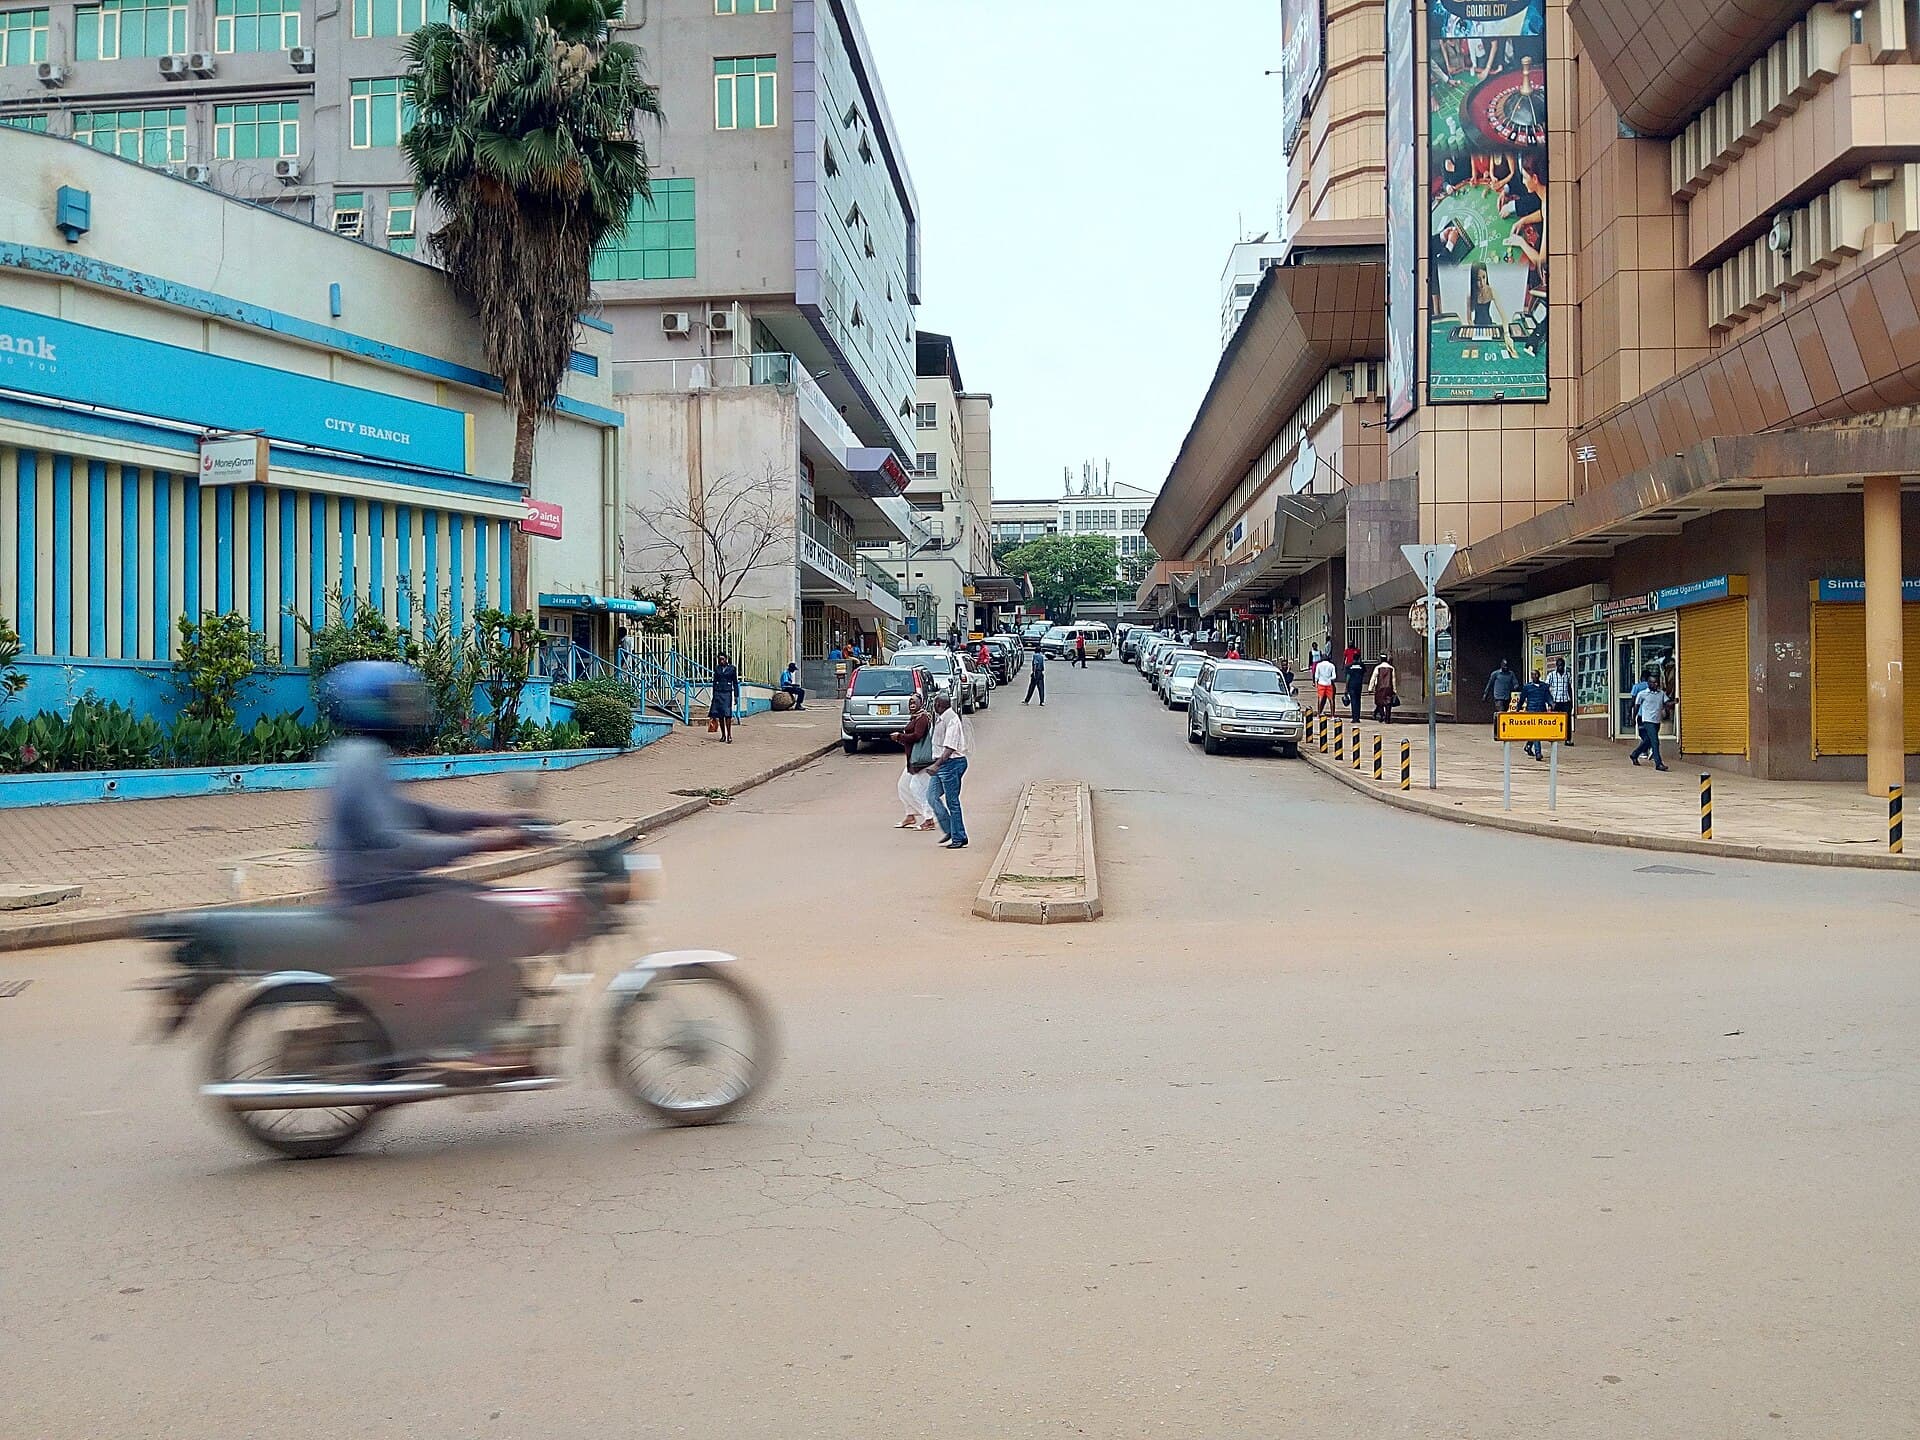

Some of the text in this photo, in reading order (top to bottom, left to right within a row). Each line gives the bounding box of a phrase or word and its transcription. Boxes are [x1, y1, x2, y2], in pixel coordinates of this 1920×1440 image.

[1466, 3, 1508, 17] GOLDEN CITY
[0, 334, 57, 361] ank
[324, 417, 410, 445] CITY BRANCH
[214, 457, 255, 469] MoneyGram
[540, 511, 560, 523] airtel
[540, 521, 557, 530] money
[817, 543, 834, 574] HOTEL
[1679, 583, 1701, 595] Uganda
[1702, 577, 1725, 589] Limited
[1828, 580, 1866, 589] Simta
[1509, 718, 1557, 726] Russell Road
